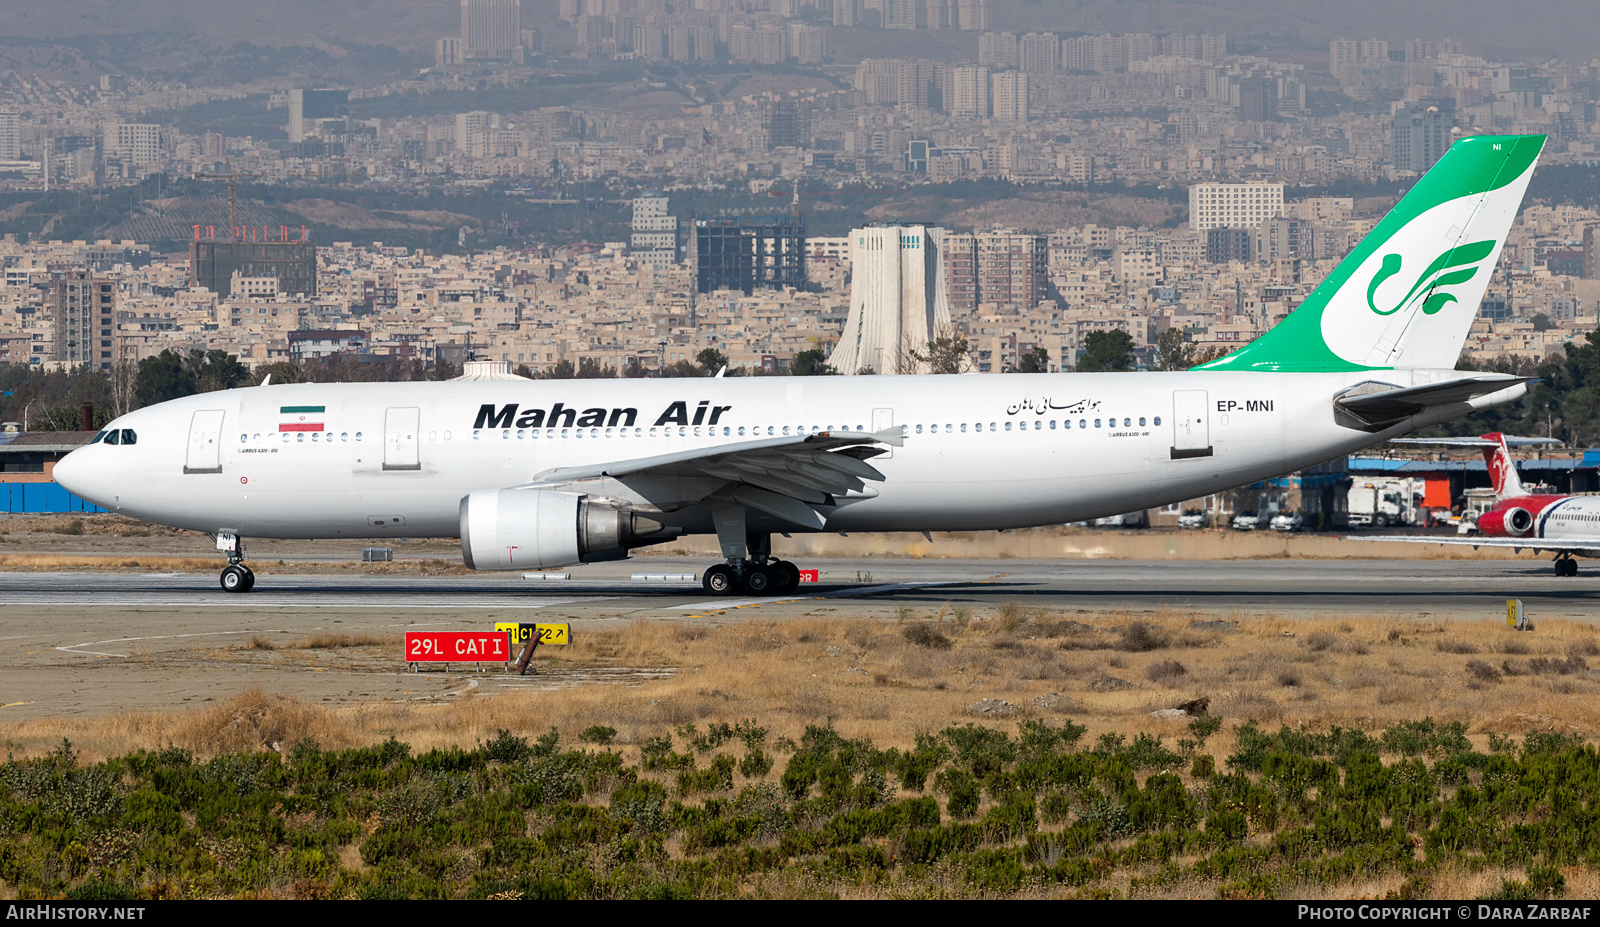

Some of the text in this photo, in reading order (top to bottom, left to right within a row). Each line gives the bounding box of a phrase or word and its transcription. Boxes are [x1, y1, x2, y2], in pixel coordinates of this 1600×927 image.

[1006, 396, 1034, 416] ماهان
[1217, 399, 1274, 412] EP-MNI
[473, 401, 733, 429] Mahan Air
[520, 627, 533, 640] C1
[411, 638, 503, 655] 29L CAT I
